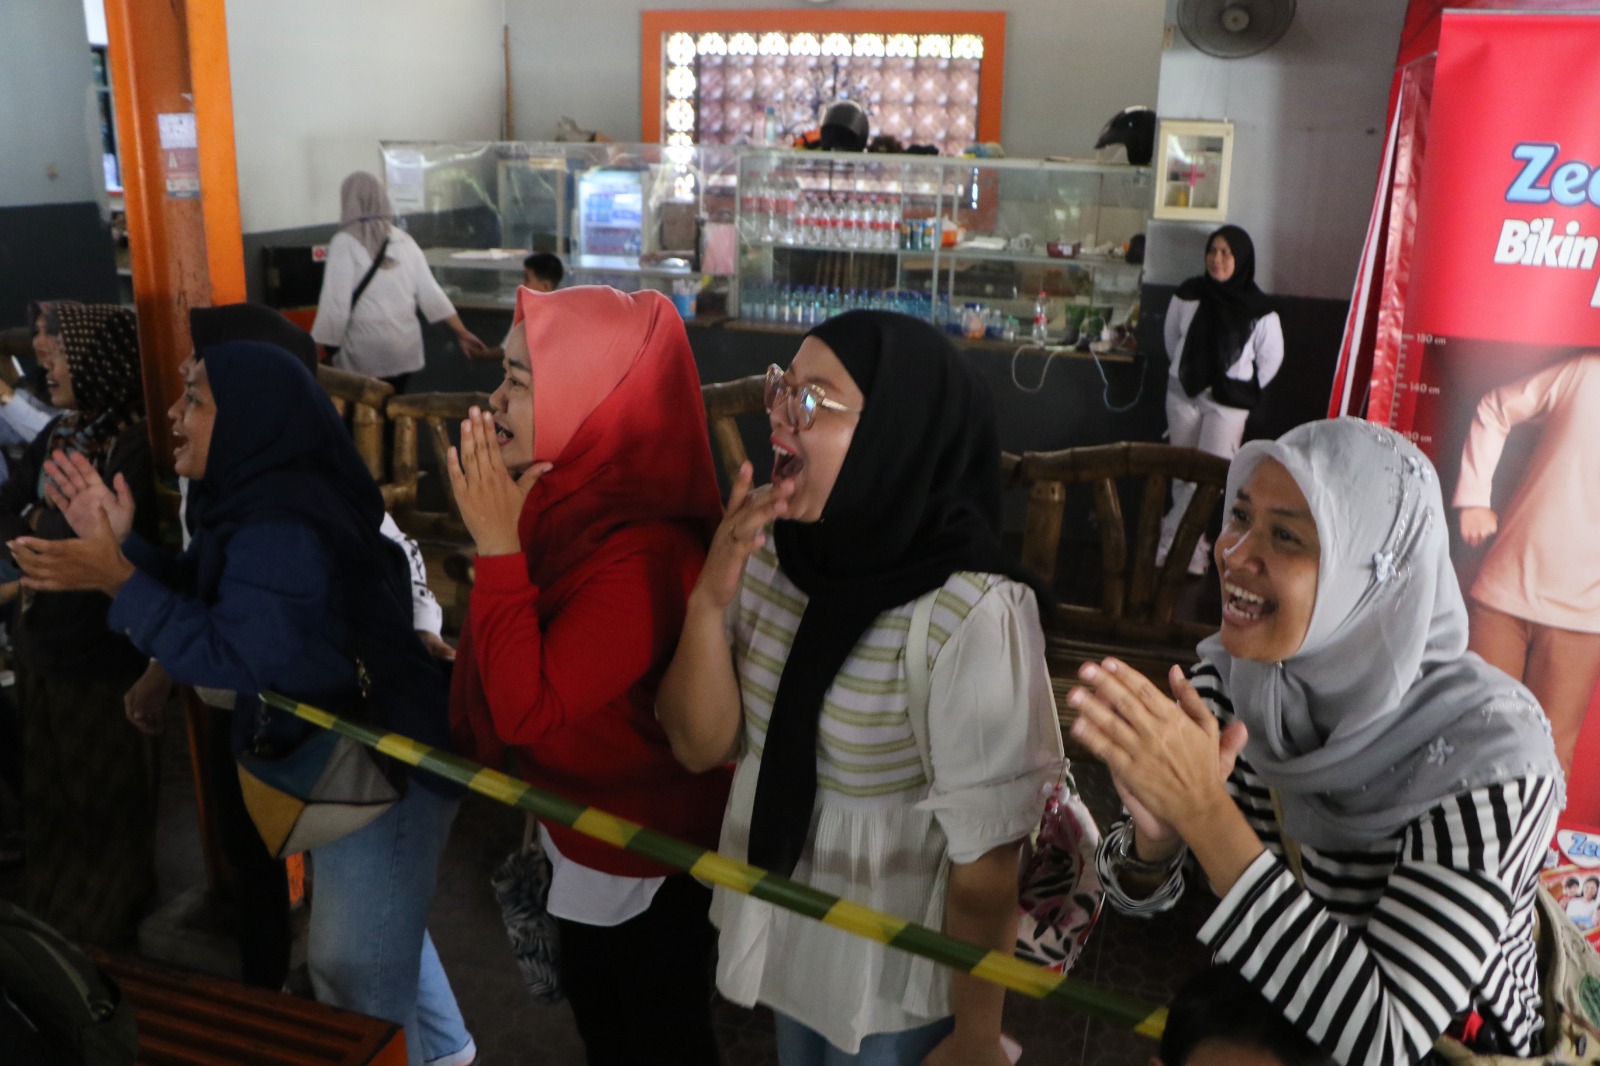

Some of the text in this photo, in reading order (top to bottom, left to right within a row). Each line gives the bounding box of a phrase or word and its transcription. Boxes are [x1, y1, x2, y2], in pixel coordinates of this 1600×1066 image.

[1494, 218, 1599, 270] Bikin
[1434, 337, 1446, 345] cm
[1428, 386, 1440, 394] cm
[1420, 434, 1432, 442] cm
